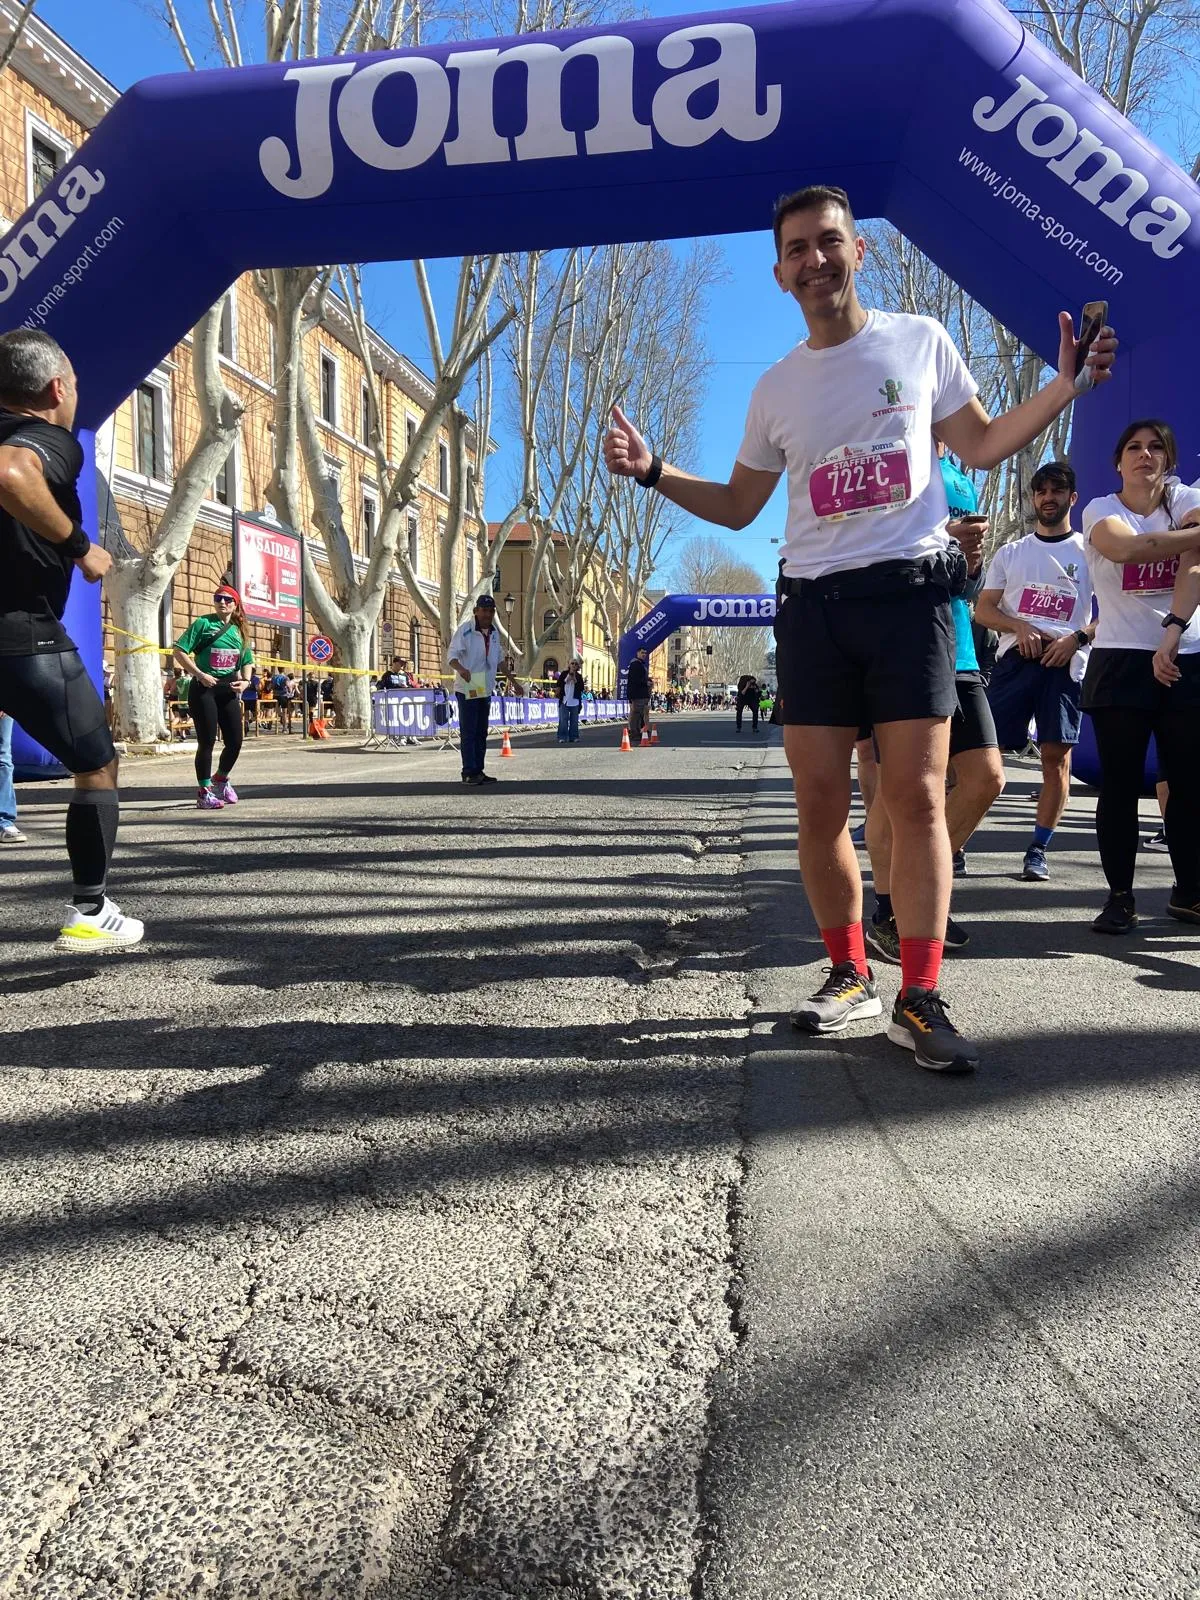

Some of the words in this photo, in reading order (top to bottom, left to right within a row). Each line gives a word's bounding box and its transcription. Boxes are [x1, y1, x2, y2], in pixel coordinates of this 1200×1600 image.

[259, 23, 782, 199] Joma
[972, 74, 1192, 260] Joma
[958, 146, 1125, 286] www.joma-sport.com
[0, 164, 106, 304] oma
[827, 461, 890, 497] 722-C
[832, 454, 883, 472] STAFFETTA
[834, 498, 842, 509] 3
[693, 598, 777, 621] Joma
[1030, 594, 1064, 611] 720-C
[636, 610, 667, 640] Joma
